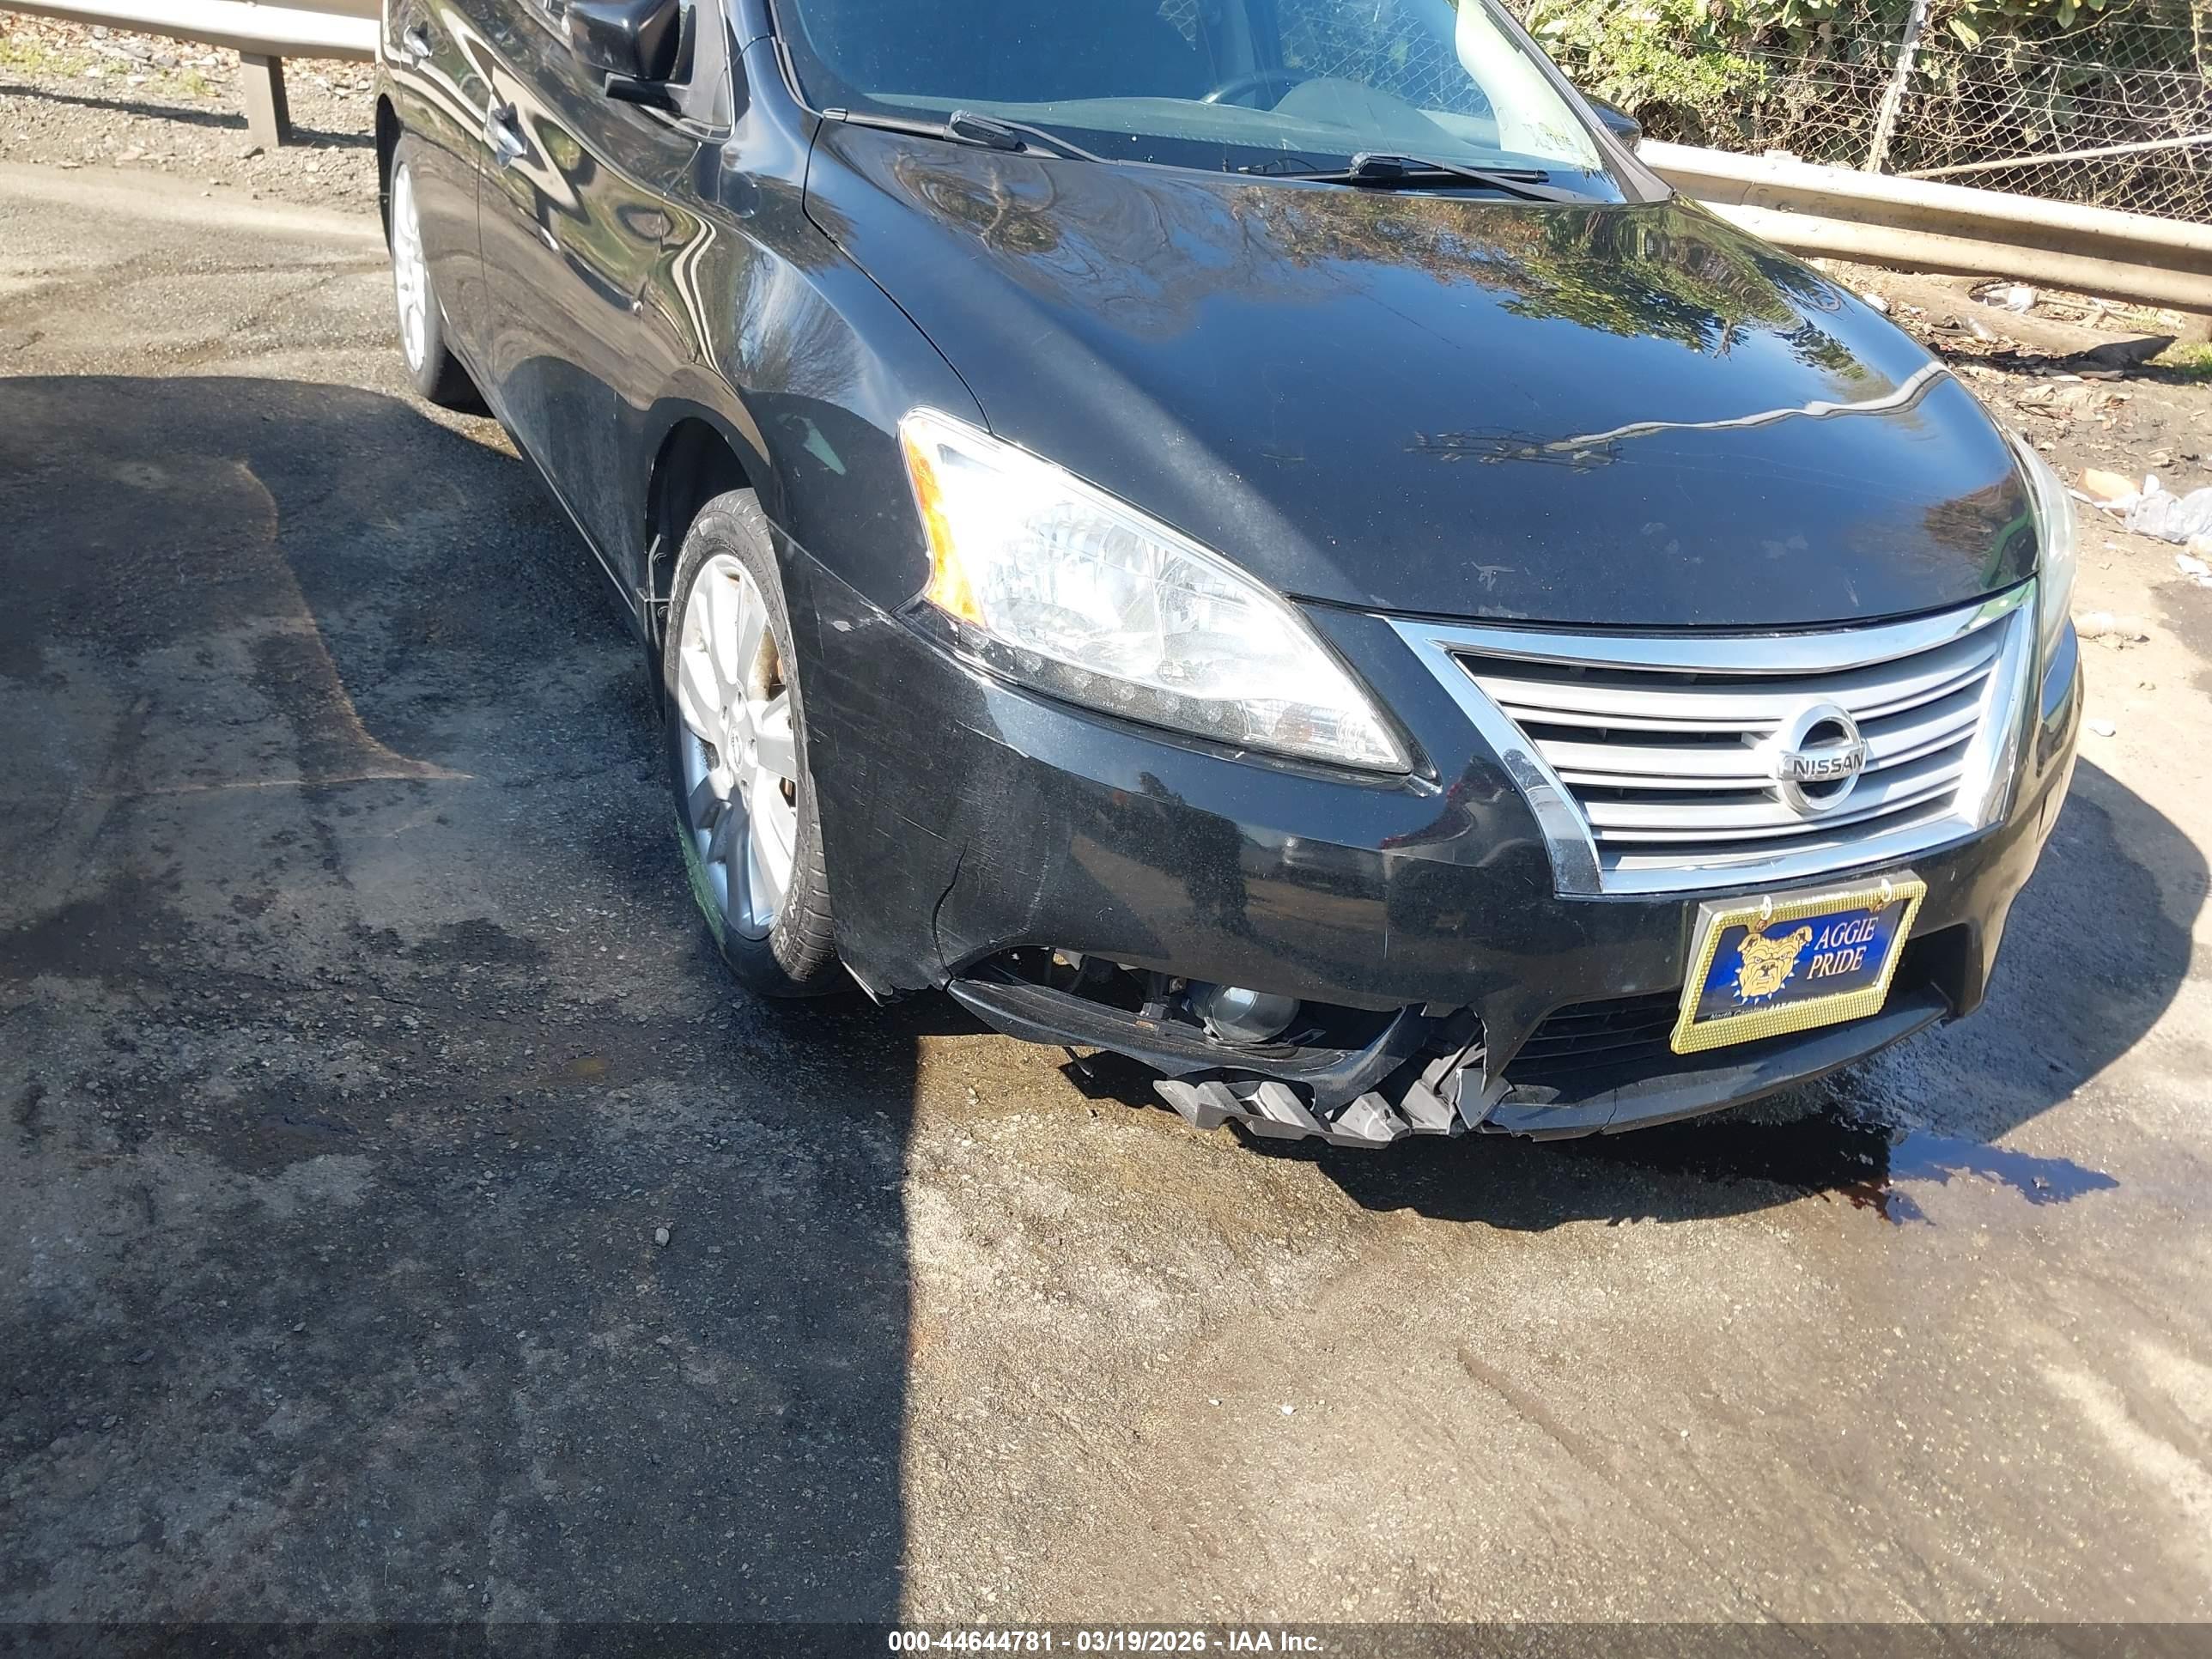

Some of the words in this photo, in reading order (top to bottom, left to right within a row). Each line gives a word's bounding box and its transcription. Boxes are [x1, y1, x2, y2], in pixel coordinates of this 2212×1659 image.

[1793, 752, 1863, 776] NISSAN
[1814, 916, 1879, 951] AGGIE
[1806, 945, 1868, 981] PRIDE
[1709, 1011, 1733, 1021] North
